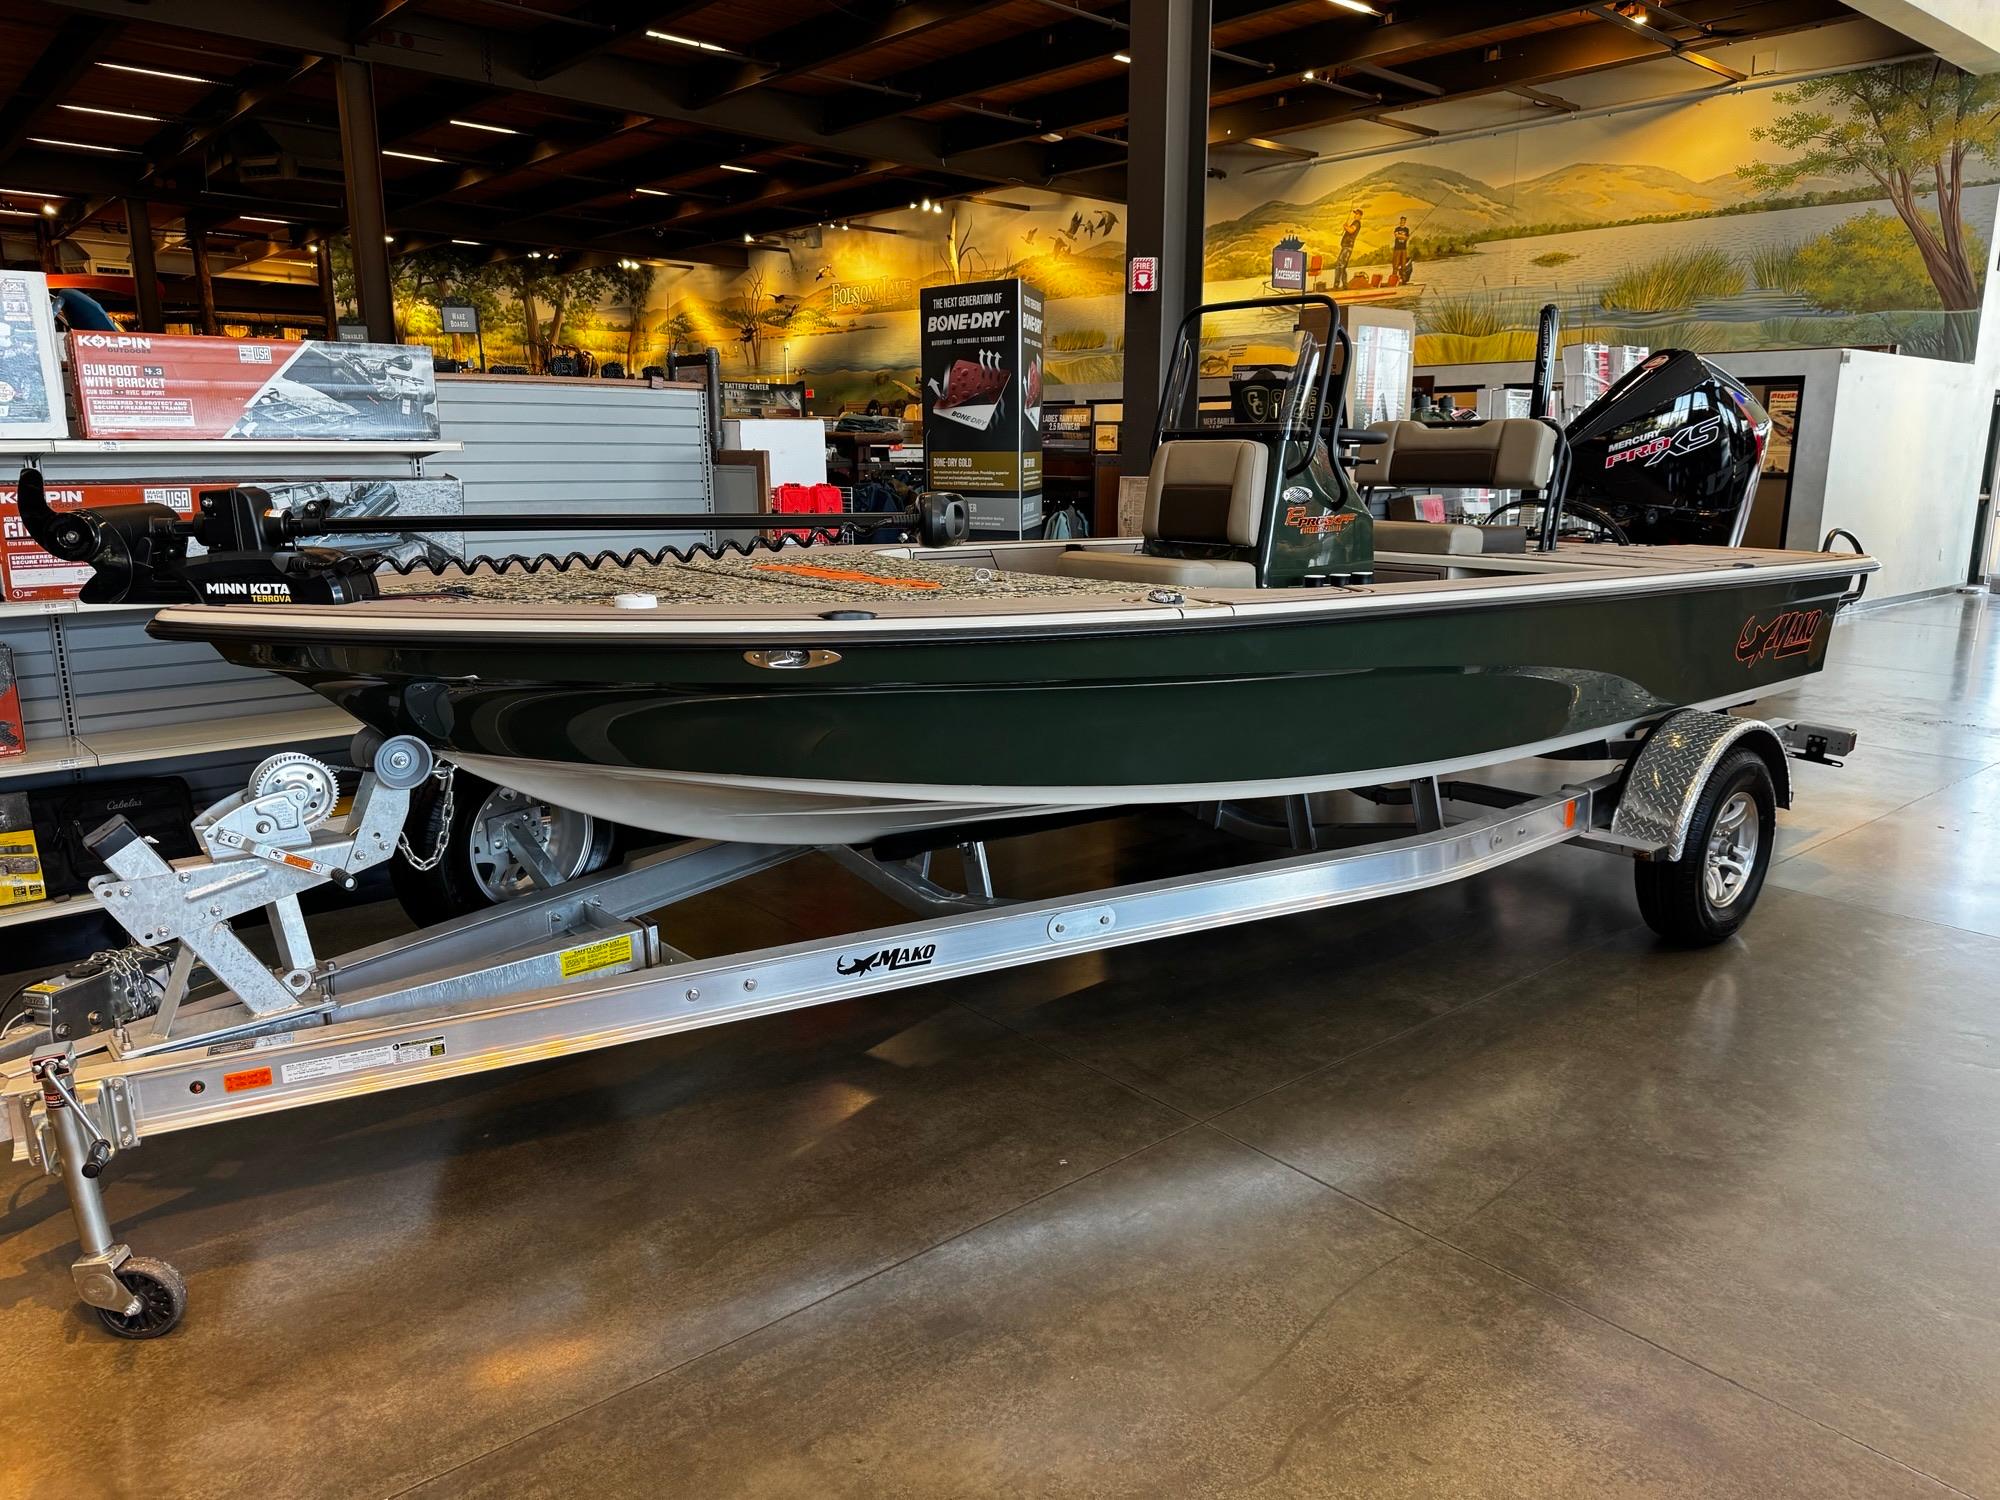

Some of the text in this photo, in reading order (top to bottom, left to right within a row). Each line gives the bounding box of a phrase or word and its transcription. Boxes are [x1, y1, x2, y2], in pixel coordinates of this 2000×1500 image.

[1136, 262, 1151, 270] FIRE
[832, 275, 912, 312] FOLSOM LAKE
[932, 292, 1002, 310] THE NEXT GENERATION OF
[450, 320, 470, 328] BOARDS
[77, 334, 152, 348] KOLPIN
[254, 348, 270, 360] USA
[82, 364, 163, 376] GUN BOOT 4.3
[84, 376, 166, 388] WITH BRACKET
[724, 382, 748, 390] BATTERY
[952, 410, 988, 426] BONE DRY
[1608, 429, 1661, 452] MERCURY
[934, 458, 972, 468] BONE-DRY GOLD
[166, 492, 190, 508] USA
[206, 582, 290, 594] MINN KOTA
[1764, 609, 1822, 660] MAKO
[574, 940, 620, 956] SAFETY CHECK LIST
[871, 944, 936, 970] MAKO
